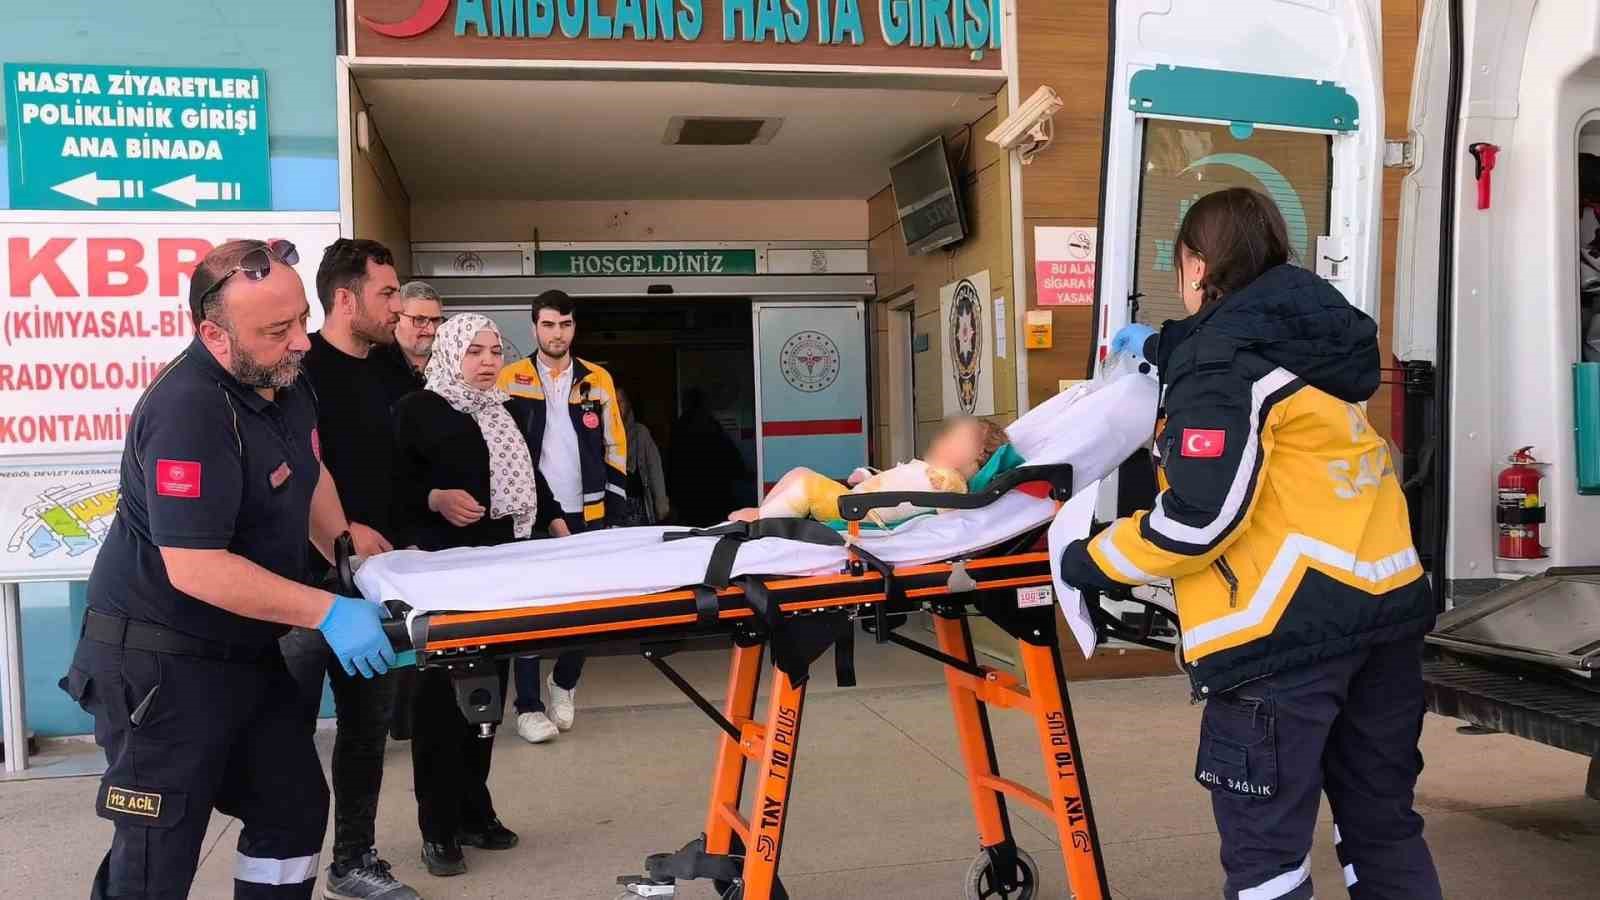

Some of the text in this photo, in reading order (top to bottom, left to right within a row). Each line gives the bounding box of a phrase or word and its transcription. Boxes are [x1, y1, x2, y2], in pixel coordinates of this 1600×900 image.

[454, 0, 704, 41] AMBULANS
[17, 70, 260, 100] HASTA ZİYARETLERİ
[22, 99, 257, 136] POLİKLİNİK GİRİŞİ
[61, 132, 224, 160] ANA BİNADA
[7, 236, 287, 298] KBR
[569, 251, 724, 274] HOŞGELDİNİZ
[1046, 711, 1067, 746] PLUS
[761, 706, 796, 830] TAY T 10 PLUS
[1055, 752, 1073, 768] 10
[111, 792, 126, 806] 112
[1063, 796, 1083, 826] TAY
